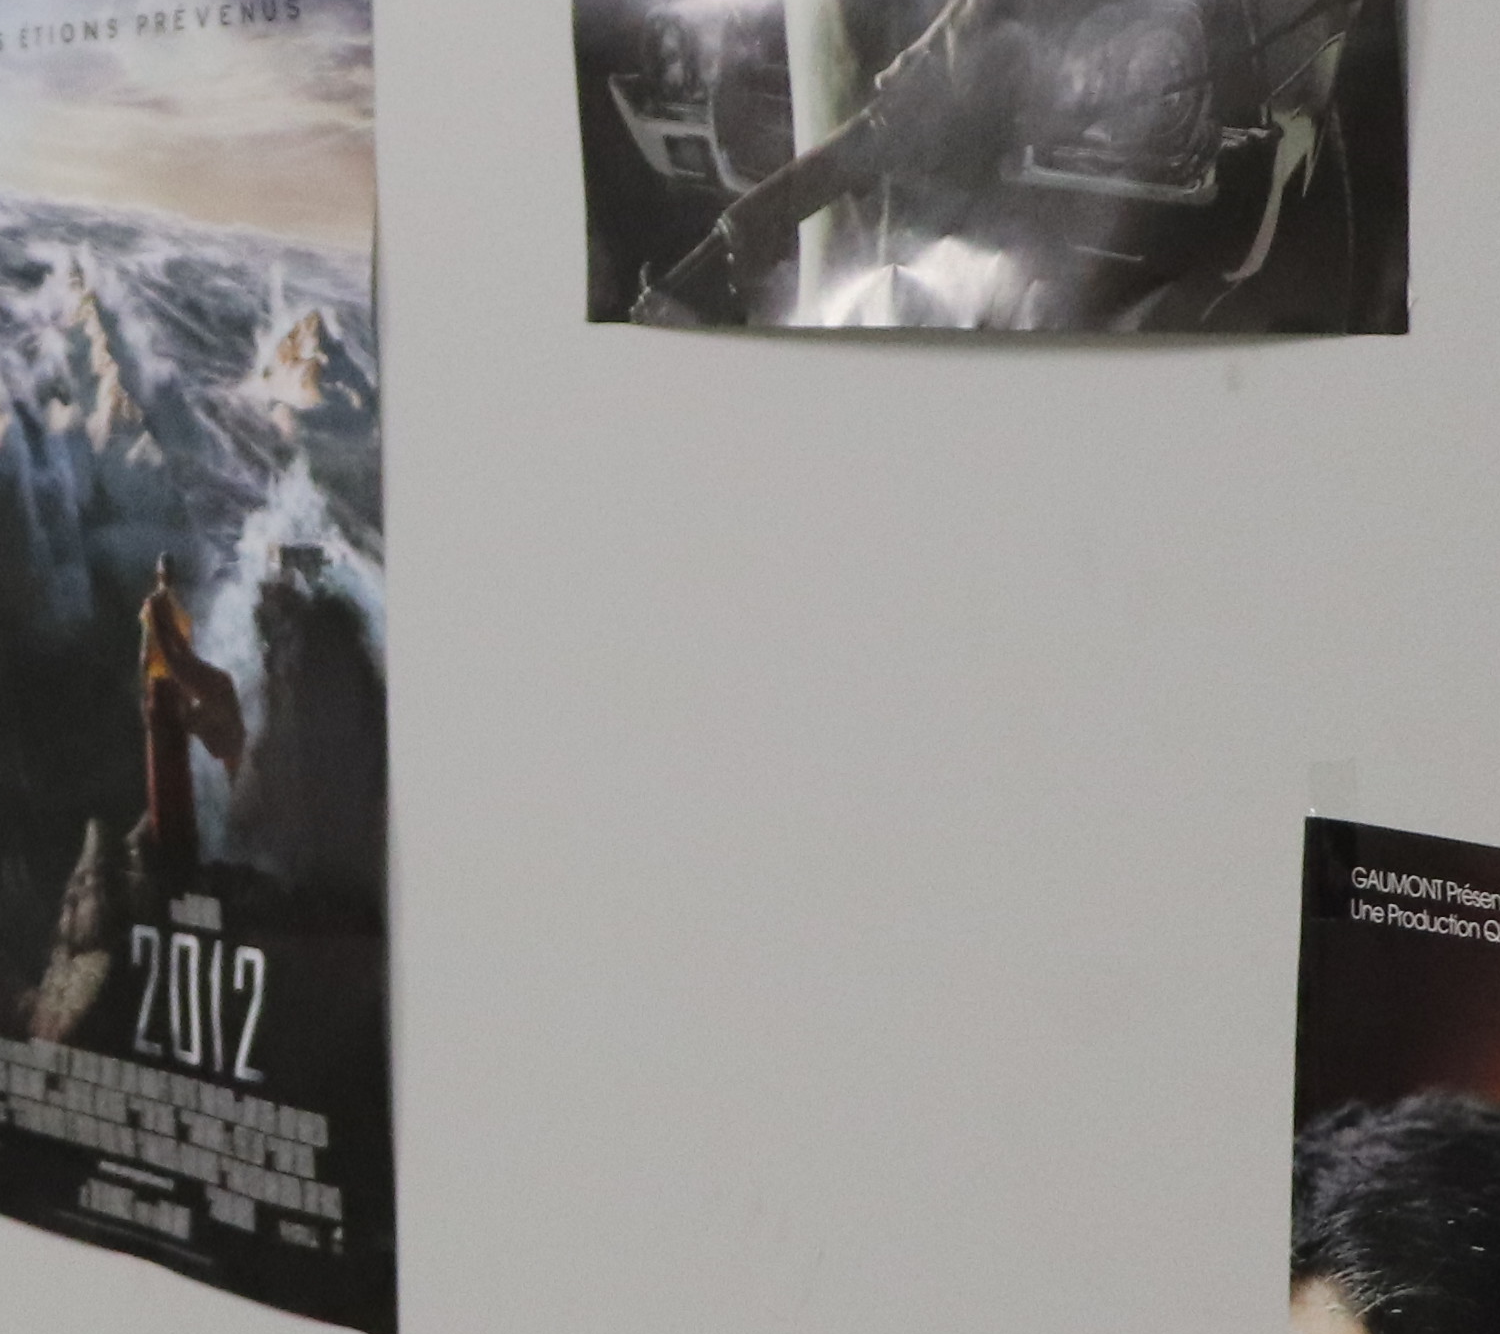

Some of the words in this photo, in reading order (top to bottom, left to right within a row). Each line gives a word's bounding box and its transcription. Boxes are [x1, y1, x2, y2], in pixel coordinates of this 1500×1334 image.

[1351, 866, 1444, 901] GAUMONT
[1350, 898, 1385, 924] Une
[1388, 903, 1481, 939] Production
[131, 924, 266, 1083] 2012
